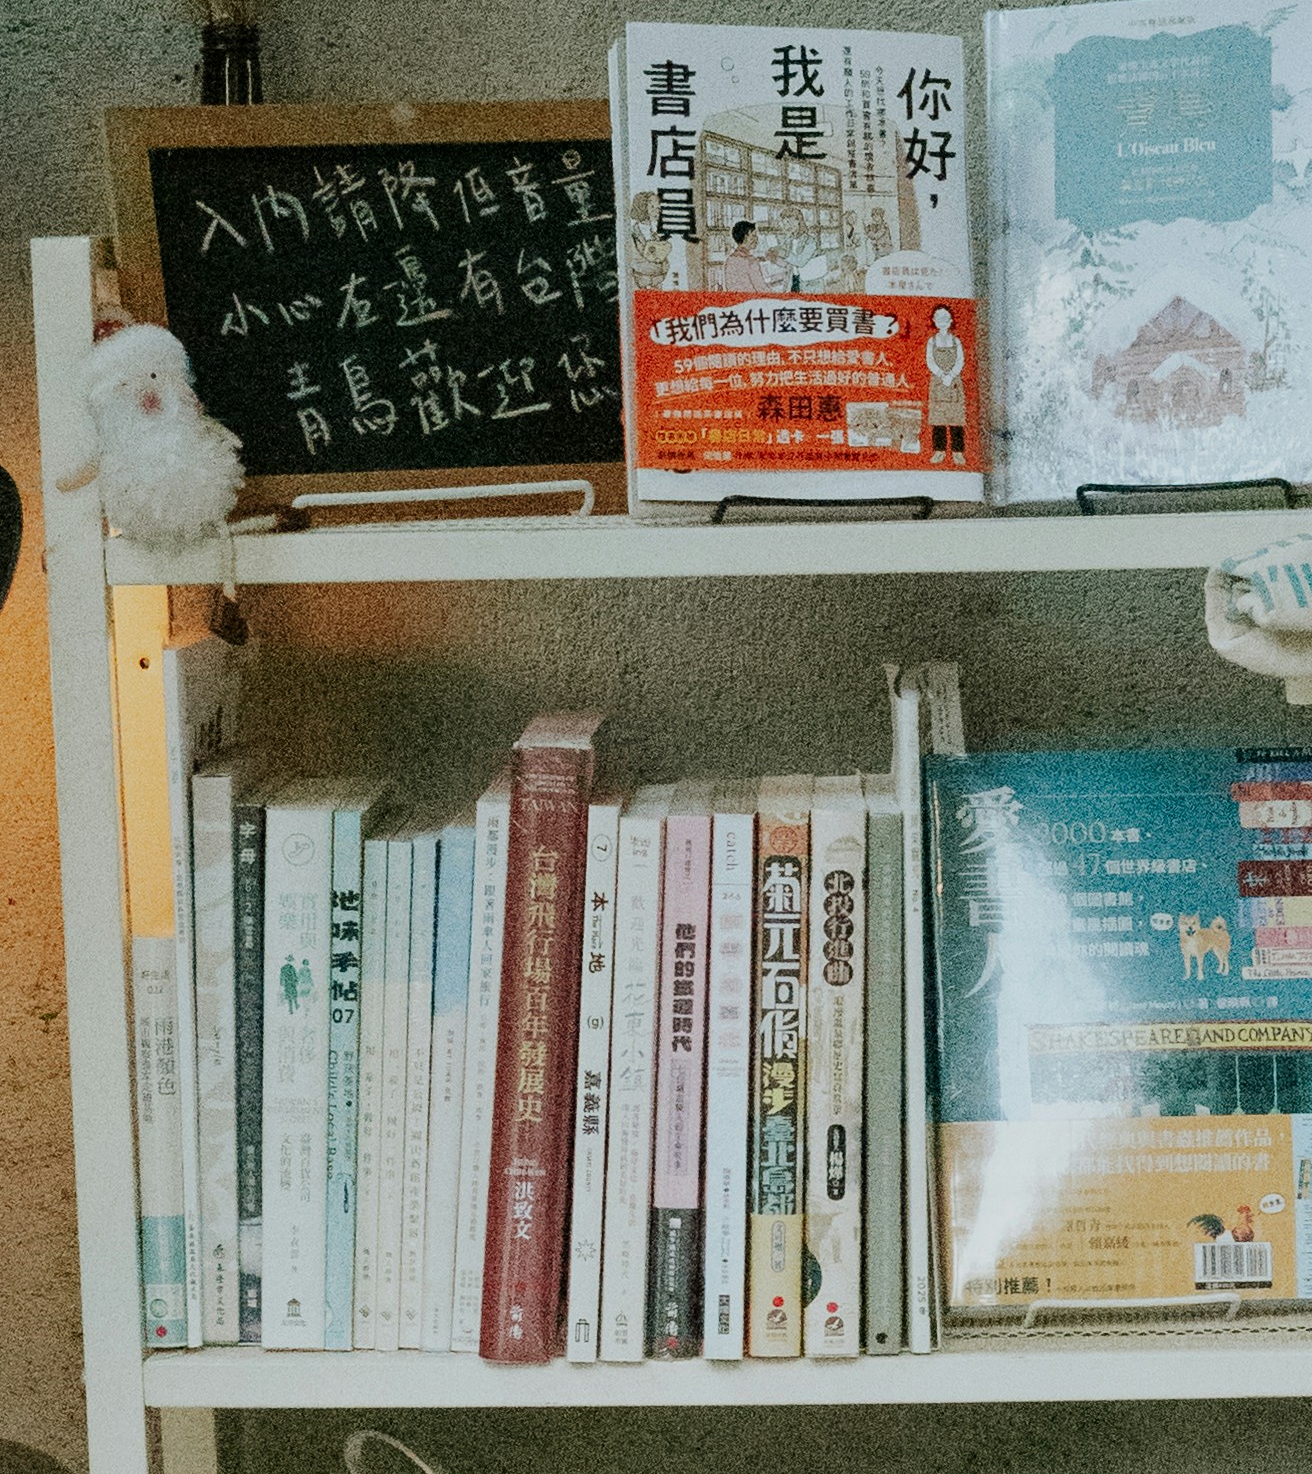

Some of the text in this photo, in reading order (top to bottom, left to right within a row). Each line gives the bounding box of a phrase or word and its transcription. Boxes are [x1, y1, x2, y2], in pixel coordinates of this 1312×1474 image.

[771, 44, 828, 162] 我是
[896, 67, 956, 210] 你好，
[642, 59, 700, 245] 書店員
[195, 148, 616, 256] 入內請降低音量
[651, 305, 912, 346] 「我們為什麼要買書？」
[725, 830, 740, 873] catch
[331, 1008, 356, 1024] 07
[514, 844, 560, 1125] 台灣飛行場百年發展史
[1203, 1028, 1236, 1044] AND
[512, 1180, 536, 1241] 洪致文
